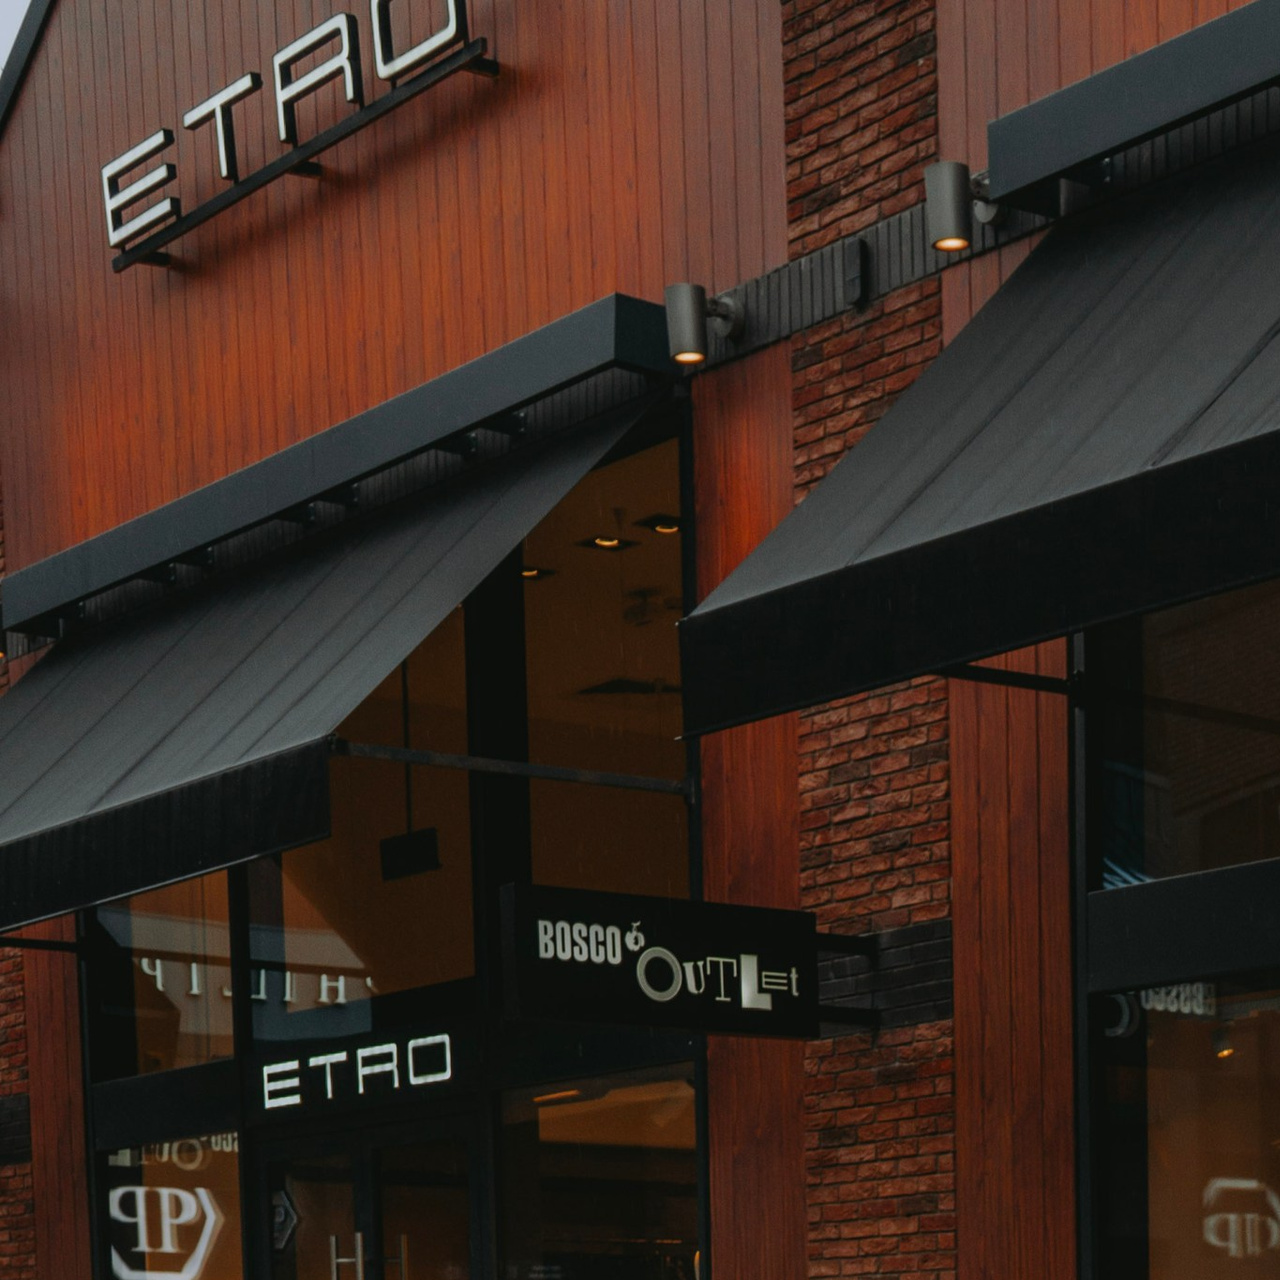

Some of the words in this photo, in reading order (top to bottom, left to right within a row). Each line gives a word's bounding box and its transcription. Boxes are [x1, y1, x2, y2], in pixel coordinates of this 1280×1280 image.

[102, 0, 468, 249] ETRO
[538, 919, 622, 965] BOSCO
[263, 1033, 452, 1109] ETRO
